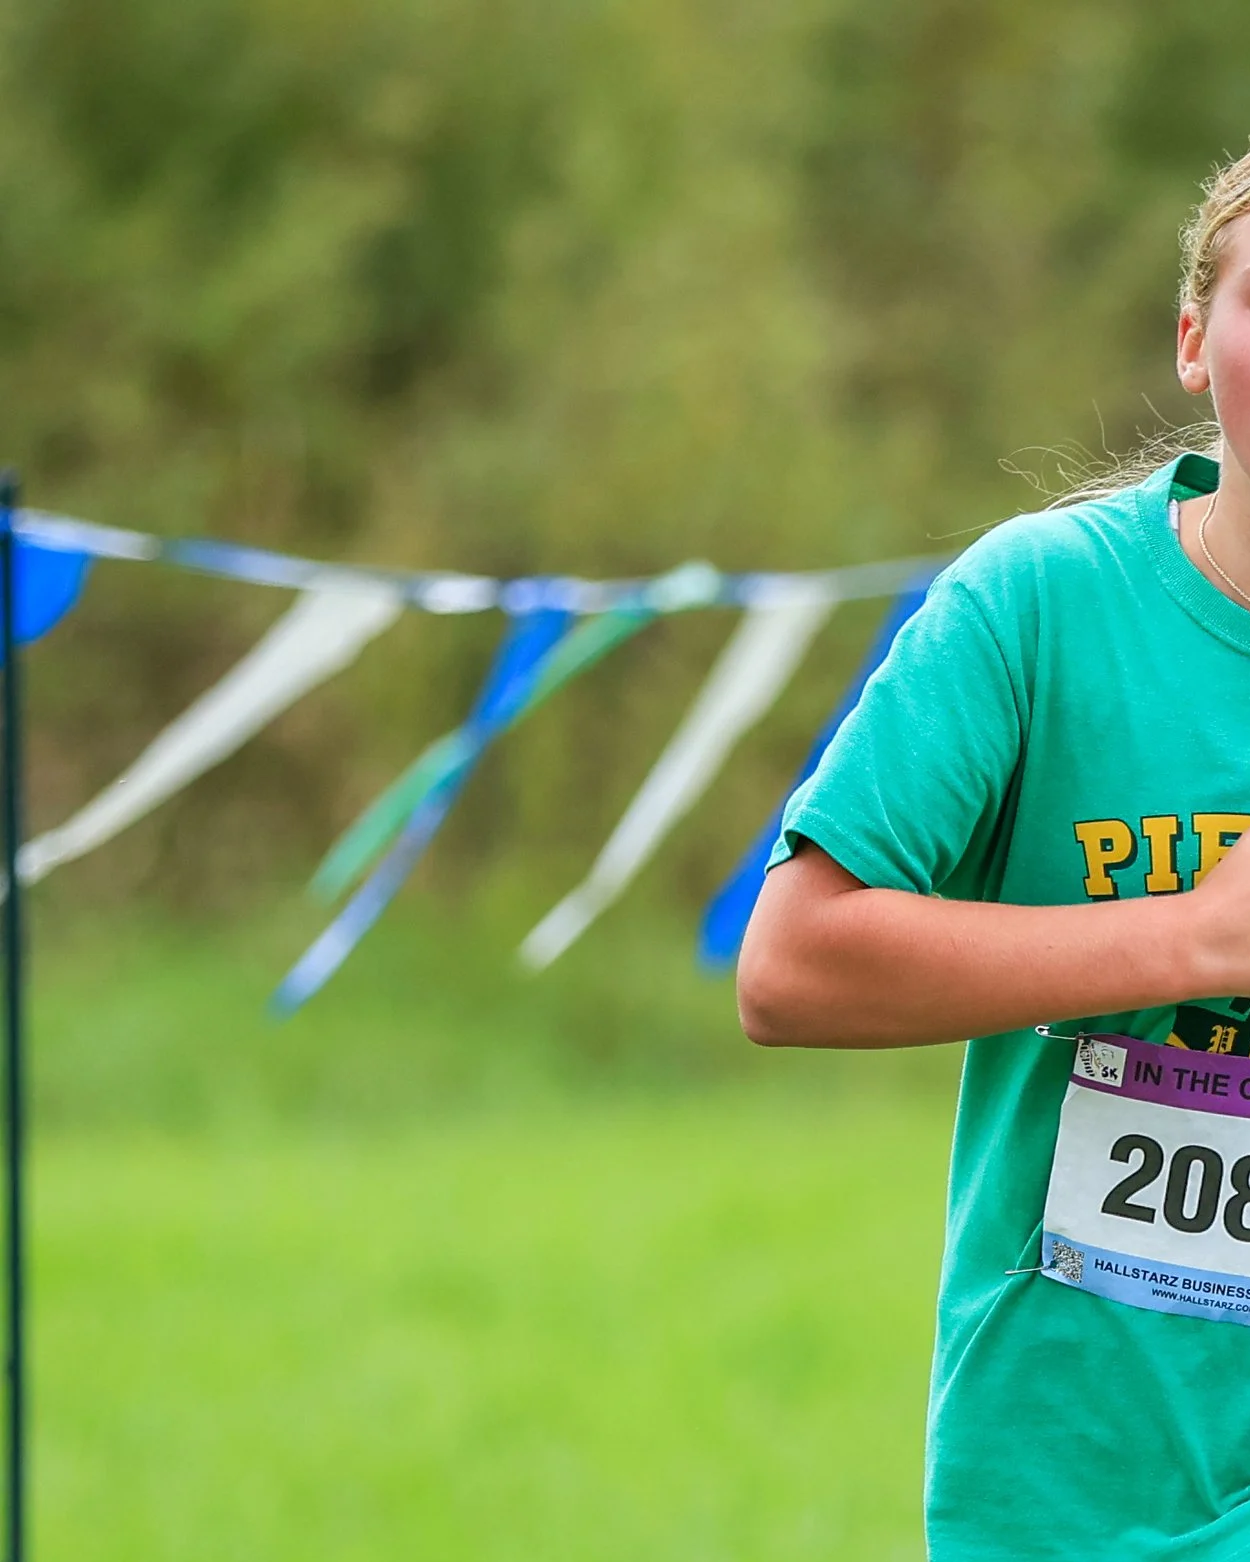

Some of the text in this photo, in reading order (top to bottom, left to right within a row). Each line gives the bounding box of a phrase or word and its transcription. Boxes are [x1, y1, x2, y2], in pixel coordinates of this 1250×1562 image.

[1134, 1061, 1163, 1086] IN
[1173, 1068, 1230, 1097] THE
[1095, 1258, 1178, 1287] HALLSTARZ
